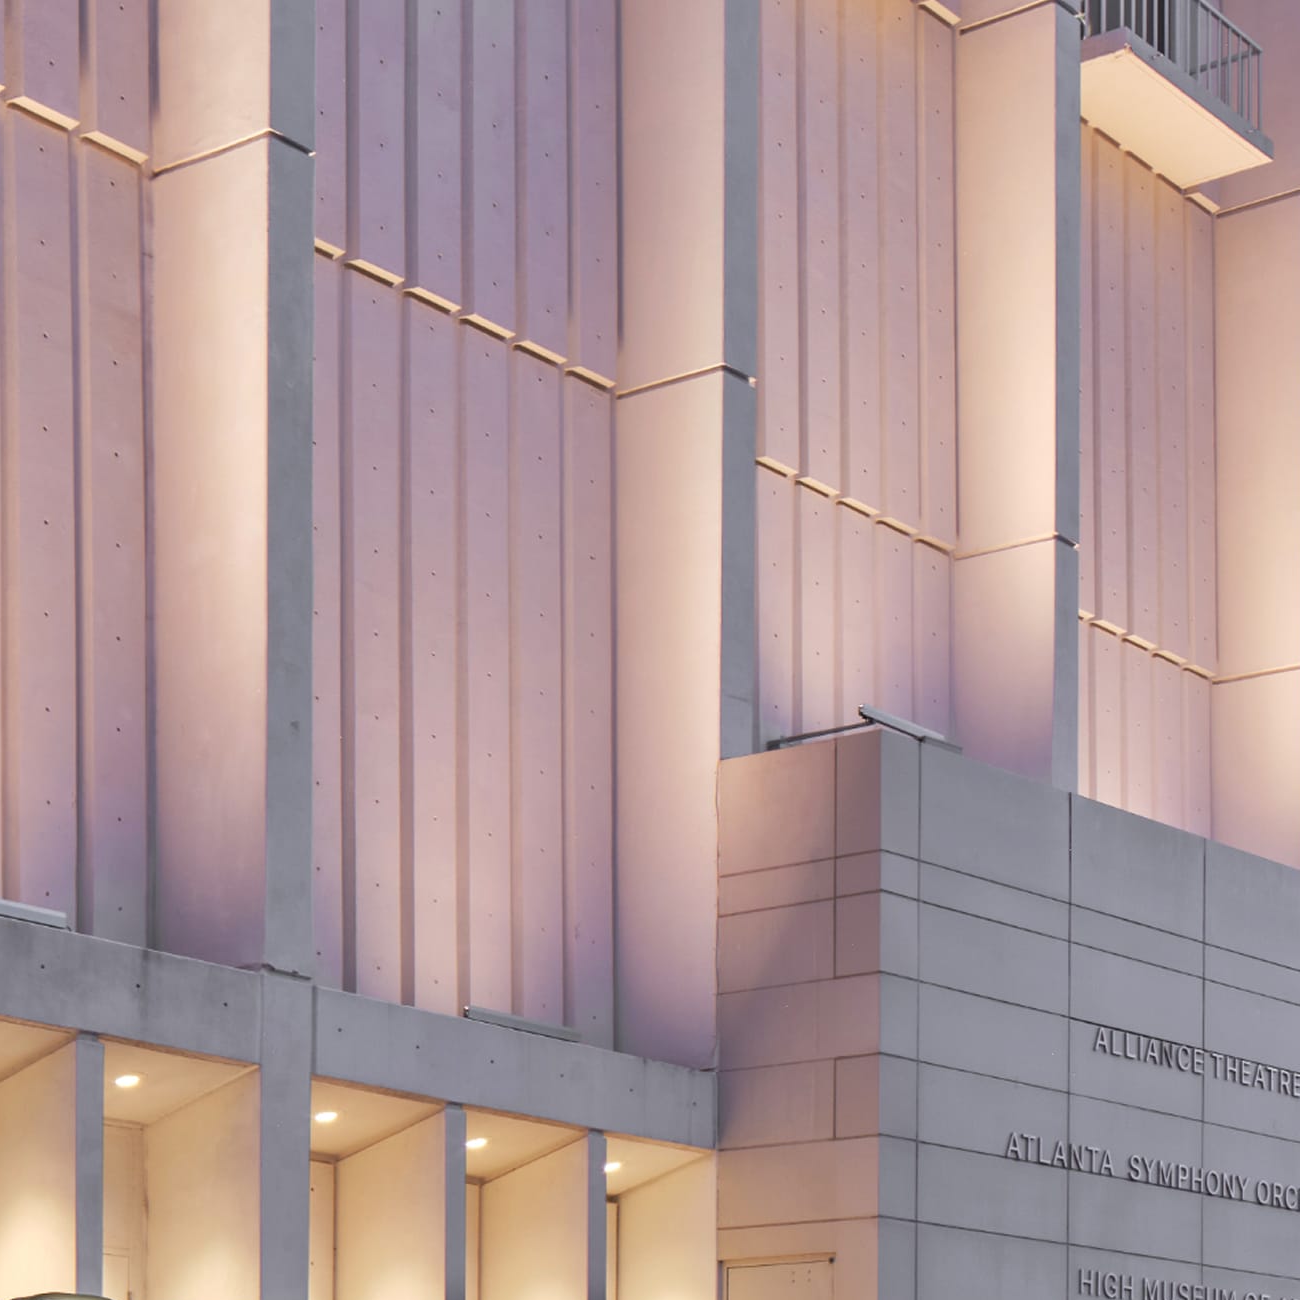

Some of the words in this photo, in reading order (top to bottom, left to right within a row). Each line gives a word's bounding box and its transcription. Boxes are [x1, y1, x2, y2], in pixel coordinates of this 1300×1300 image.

[1093, 1026, 1204, 1075] ALLIANCE
[1005, 1131, 1114, 1176] ATLANTA
[1127, 1154, 1250, 1200] SYMPHONY
[1078, 1268, 1133, 1300] HIGH
